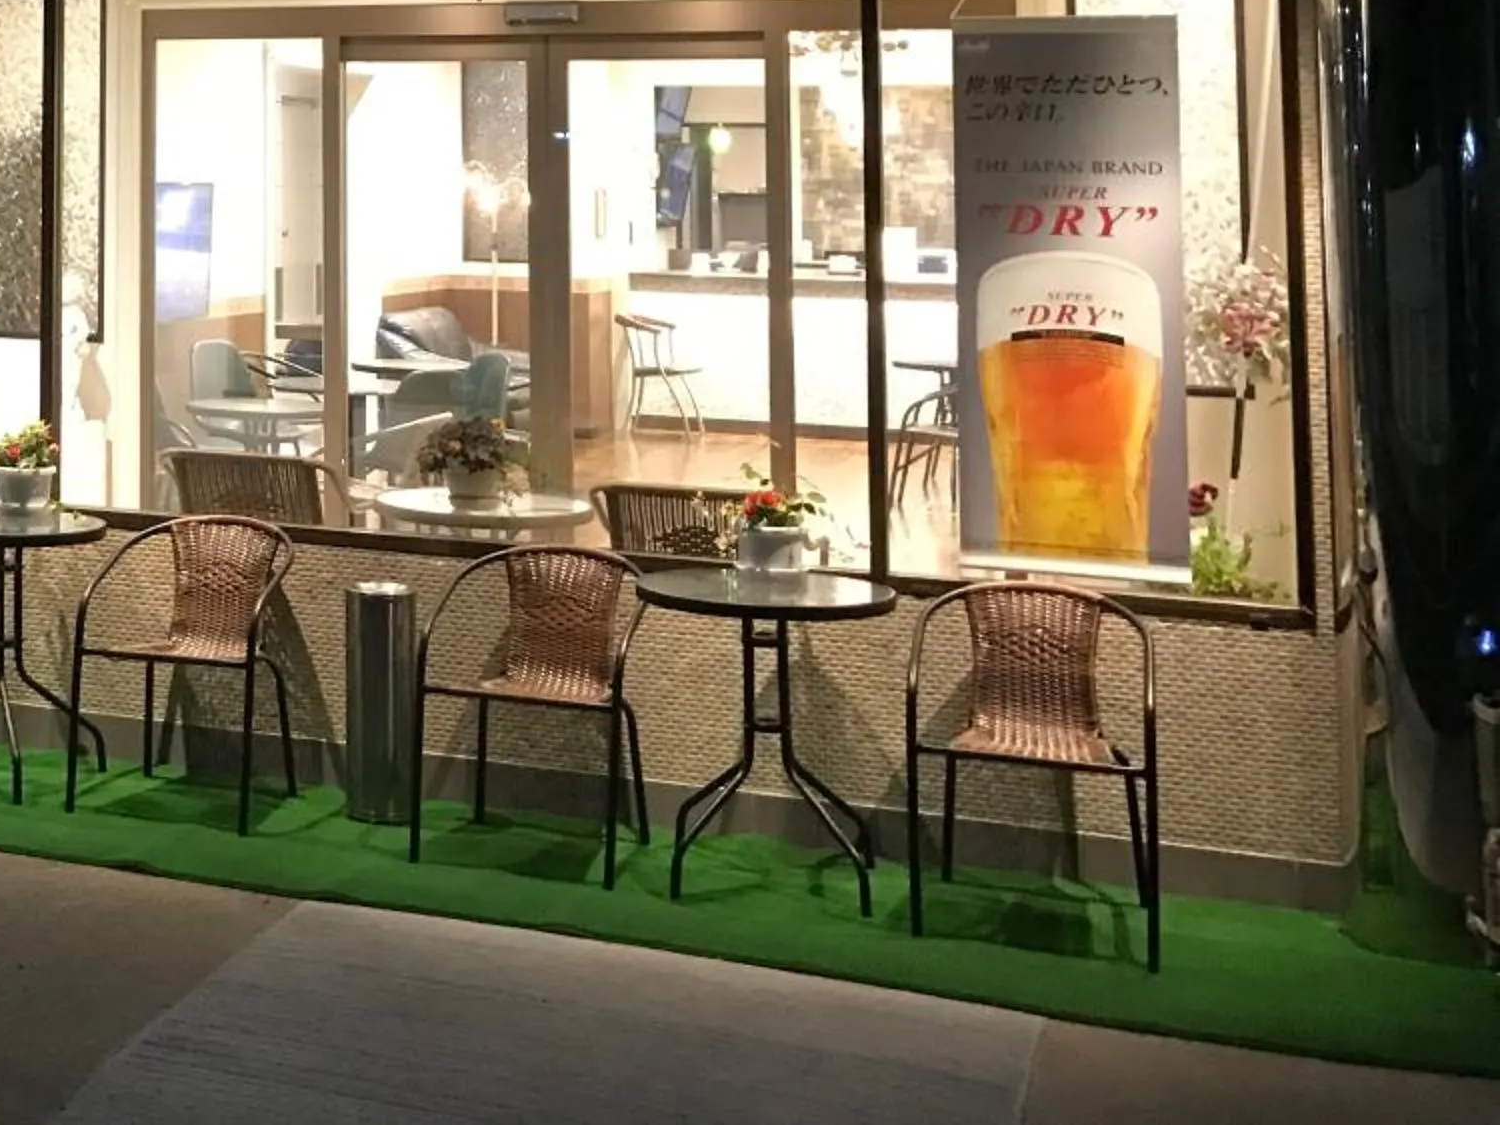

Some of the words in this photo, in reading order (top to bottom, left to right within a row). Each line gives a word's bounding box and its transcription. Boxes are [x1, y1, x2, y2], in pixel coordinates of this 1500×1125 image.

[974, 158, 1011, 174] THE
[1020, 159, 1083, 174] JAPAN
[1091, 160, 1164, 176] BRAND
[1038, 186, 1109, 201] SUPER
